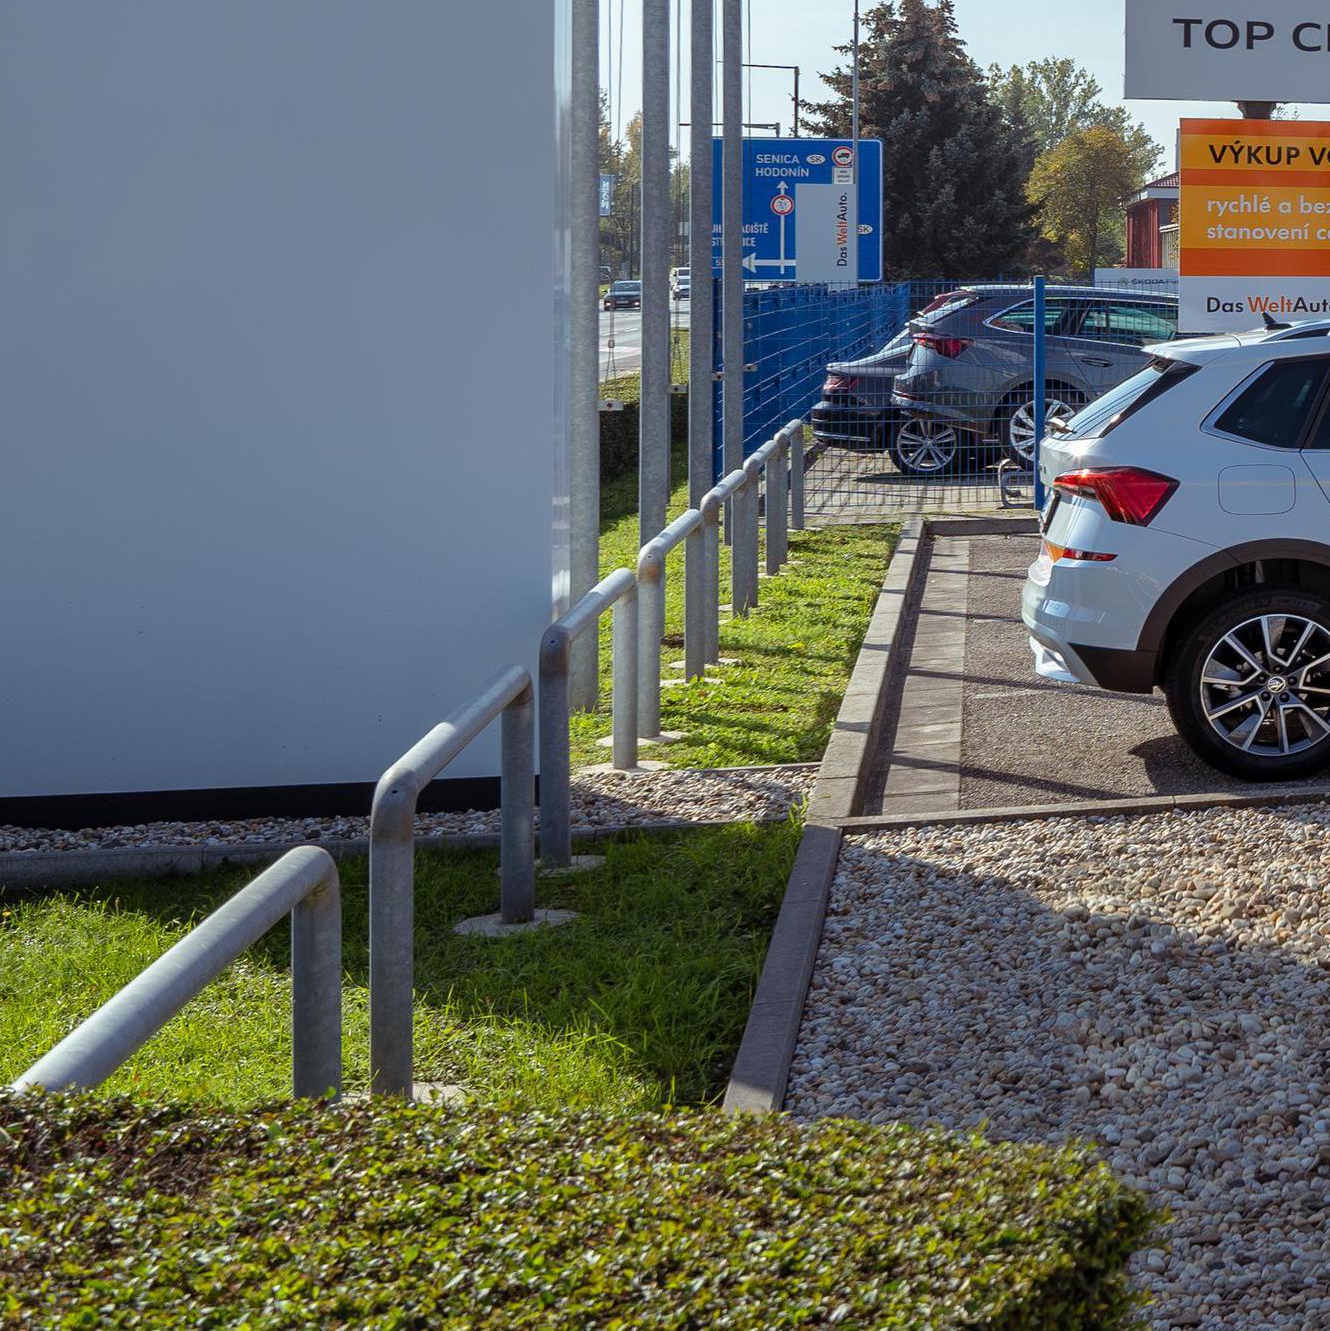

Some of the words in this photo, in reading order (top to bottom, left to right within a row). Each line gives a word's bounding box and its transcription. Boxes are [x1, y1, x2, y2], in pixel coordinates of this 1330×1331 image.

[1172, 18, 1275, 50] TOP
[756, 154, 800, 164] SENICA
[1208, 140, 1301, 166] VÝKUP
[755, 166, 810, 177] HODONÍN
[1207, 195, 1272, 217] rychlé
[1278, 201, 1292, 214] a
[1207, 223, 1310, 240] stanovení
[837, 247, 848, 267] Das
[1206, 297, 1244, 313] Das
